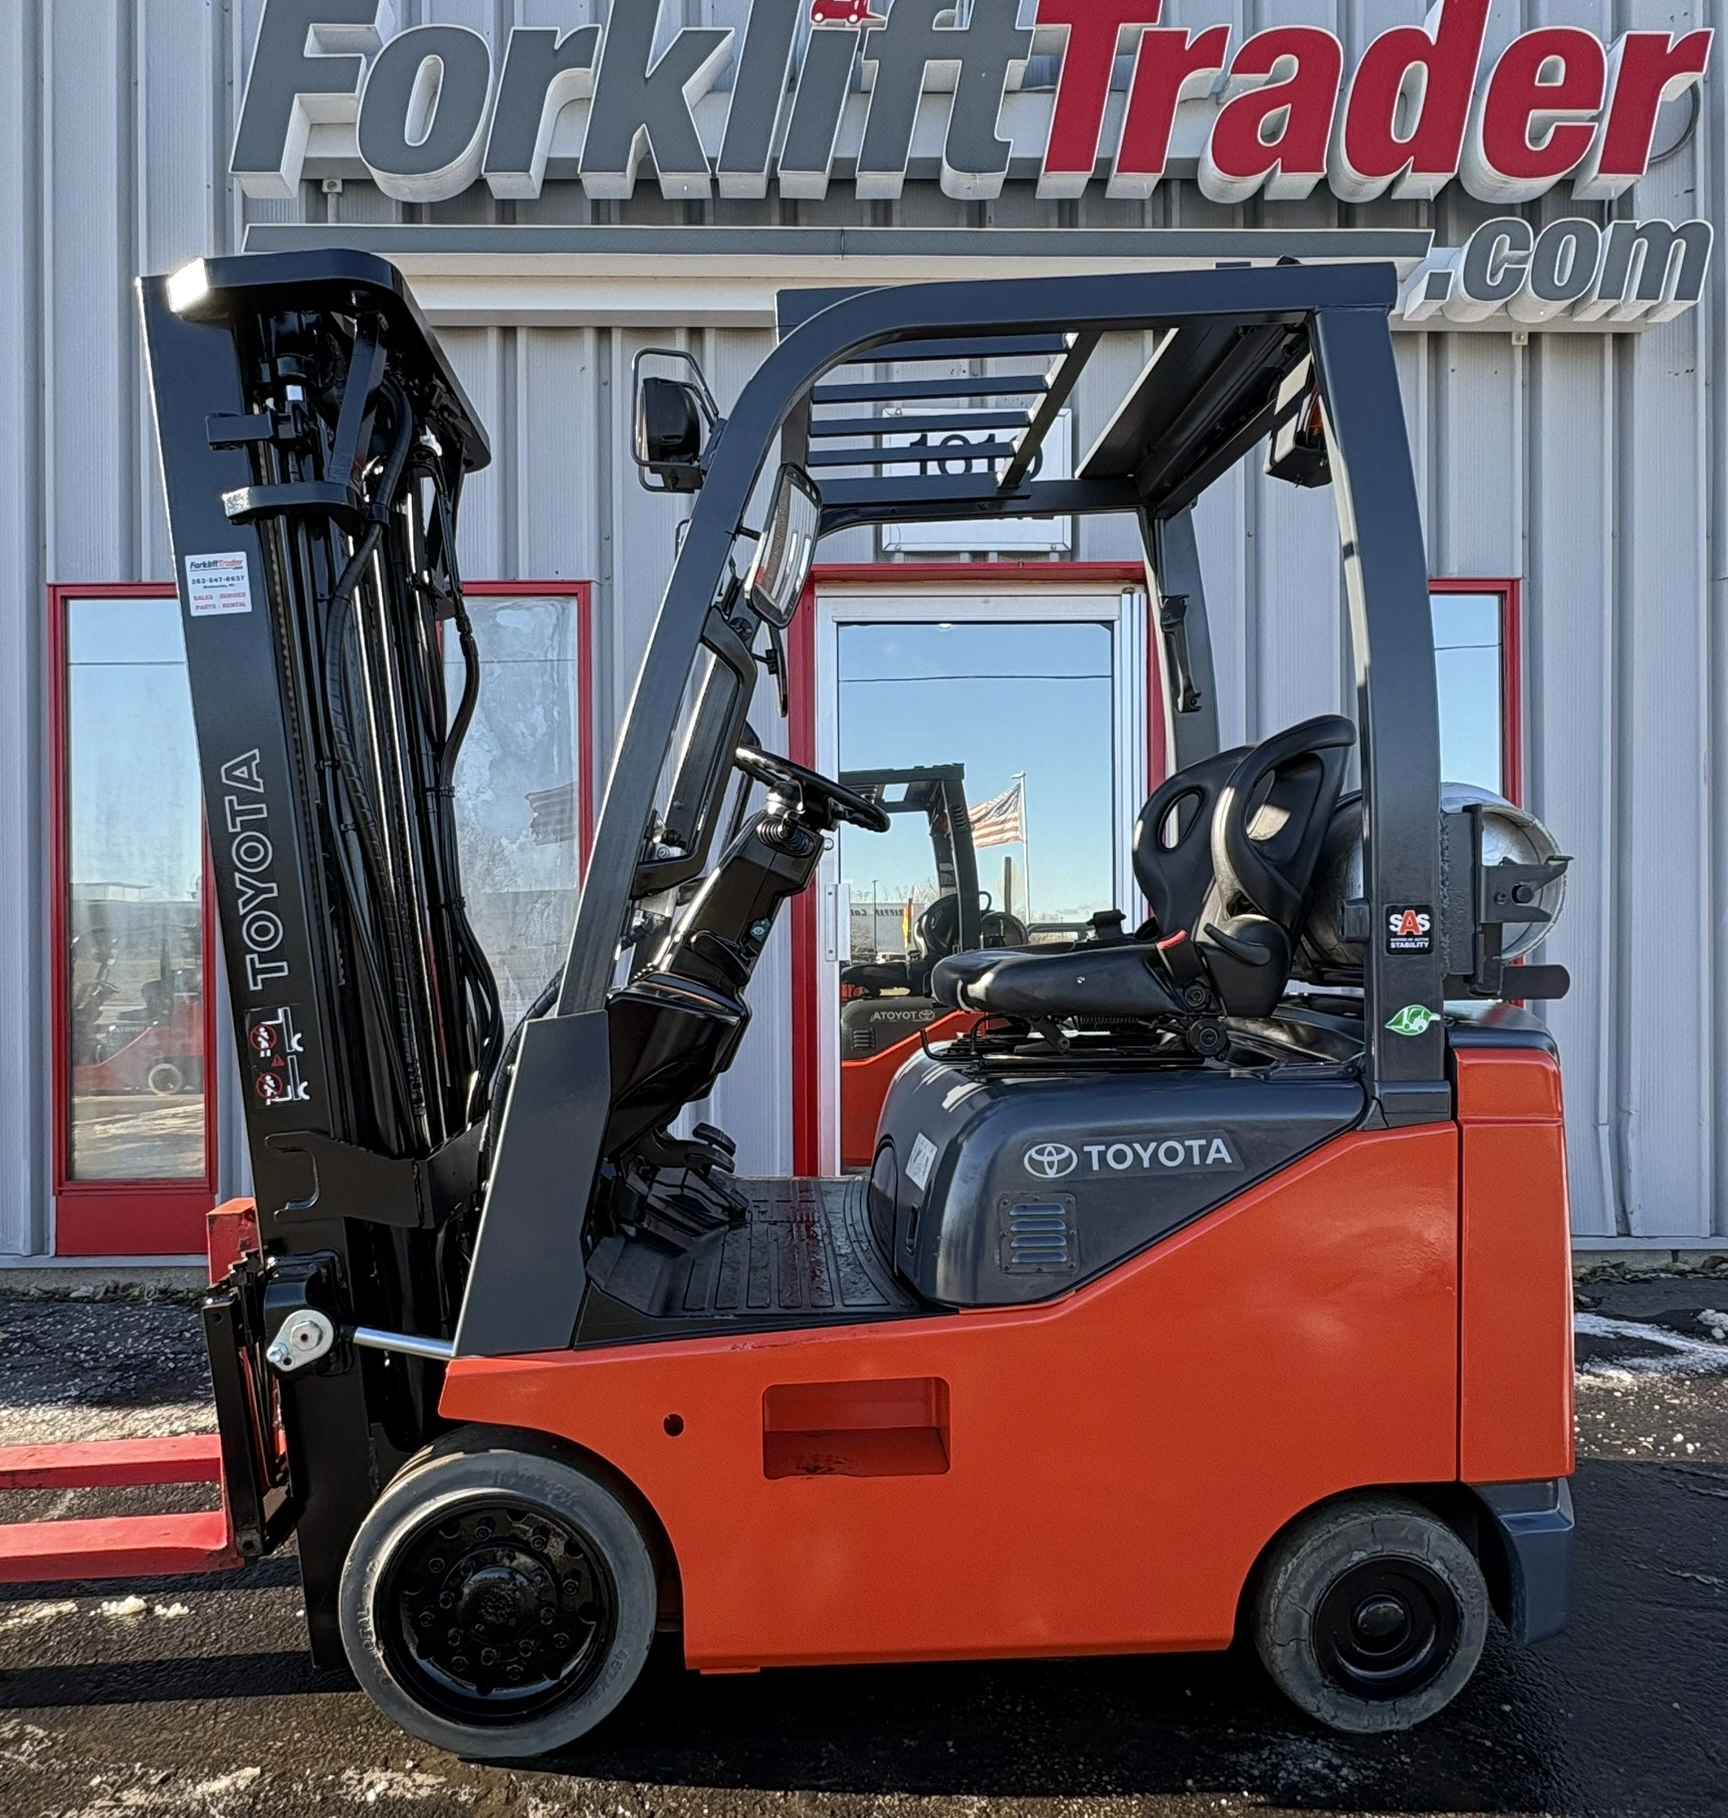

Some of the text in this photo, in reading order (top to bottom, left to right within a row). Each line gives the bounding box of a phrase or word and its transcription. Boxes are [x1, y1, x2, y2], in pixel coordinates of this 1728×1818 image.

[1425, 216, 1715, 304] .com
[220, 748, 290, 992] TOYOTA
[1389, 910, 1431, 935] SAS
[1083, 1138, 1233, 1171] TOYOTA
